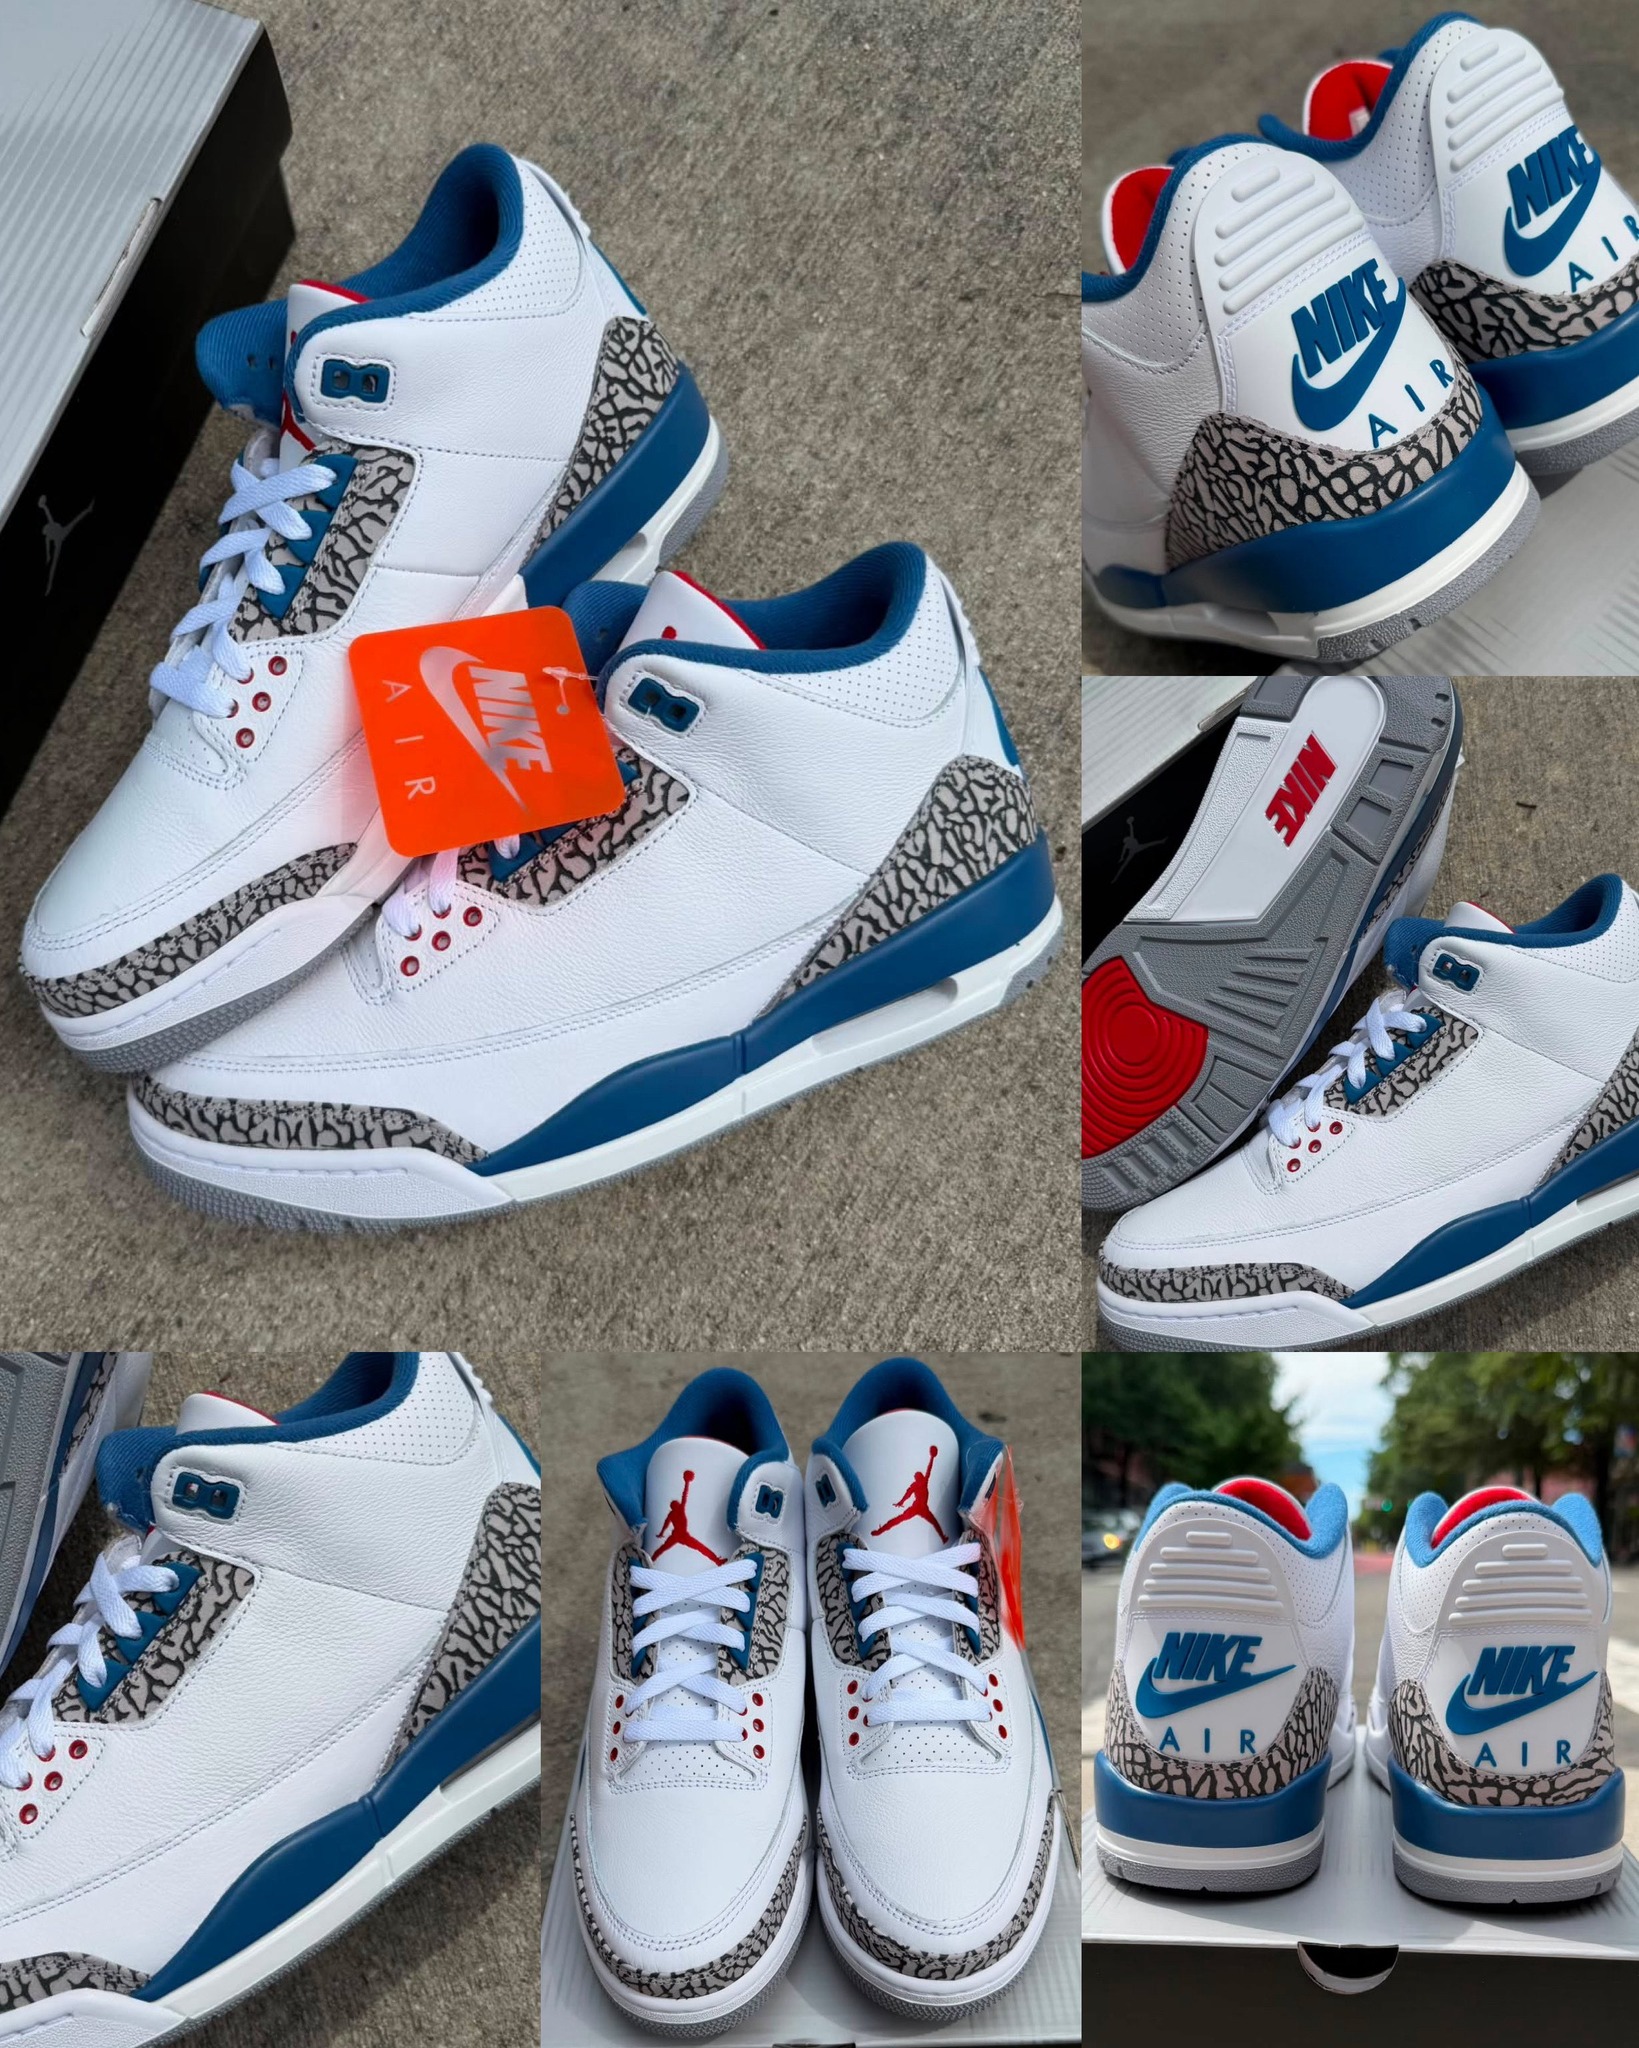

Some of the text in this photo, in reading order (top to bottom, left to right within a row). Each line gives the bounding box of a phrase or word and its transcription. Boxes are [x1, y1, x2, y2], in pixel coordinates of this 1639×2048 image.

[1507, 125, 1595, 229] NIKE
[1291, 258, 1391, 379] NIKE
[1368, 358, 1455, 448] AIR
[382, 679, 436, 800] AIR
[468, 666, 552, 774] NIKE
[1265, 731, 1338, 848] NIKE
[1154, 1631, 1262, 1682] NIKE
[1467, 1645, 1576, 1696] NIKE
[1160, 1727, 1256, 1754] AIR
[1475, 1739, 1573, 1768] AIR
